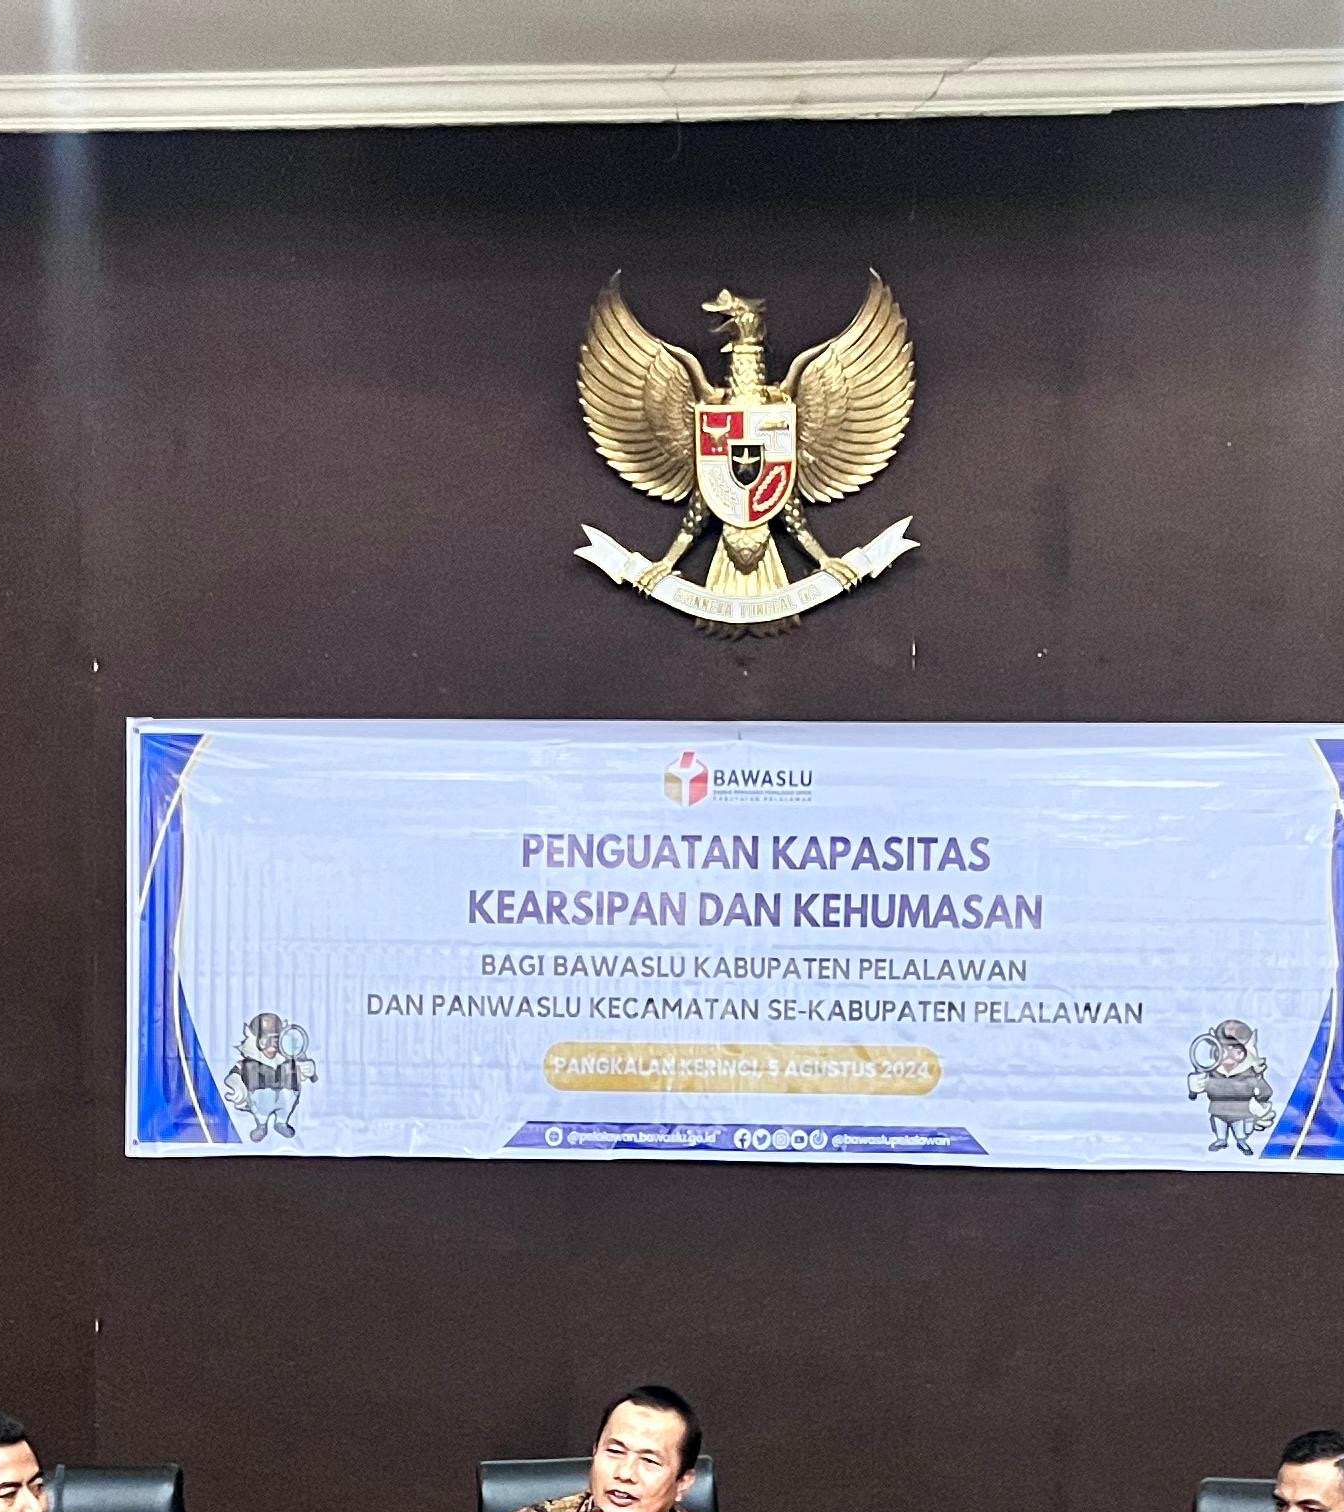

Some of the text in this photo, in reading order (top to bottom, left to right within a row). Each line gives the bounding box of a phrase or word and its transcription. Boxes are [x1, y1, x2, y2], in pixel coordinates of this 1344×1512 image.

[713, 769, 813, 788] BAWASLU
[522, 832, 991, 872] PENGUATAN KAPASITAS
[468, 889, 1043, 930] KEARSIPAN DAN KEHUMASAN
[481, 953, 1027, 982] BAGI BAWASLU KABUPATEN PELALAWAN
[367, 993, 1143, 1025] DAN PANWASLU KECAMATAN SE-KABUPATEN PELALAWAN
[553, 1056, 675, 1076] PANGKALAN
[767, 1059, 780, 1077] 5
[784, 1060, 877, 1078] AGUSTUS
[880, 1061, 932, 1079] 2024
